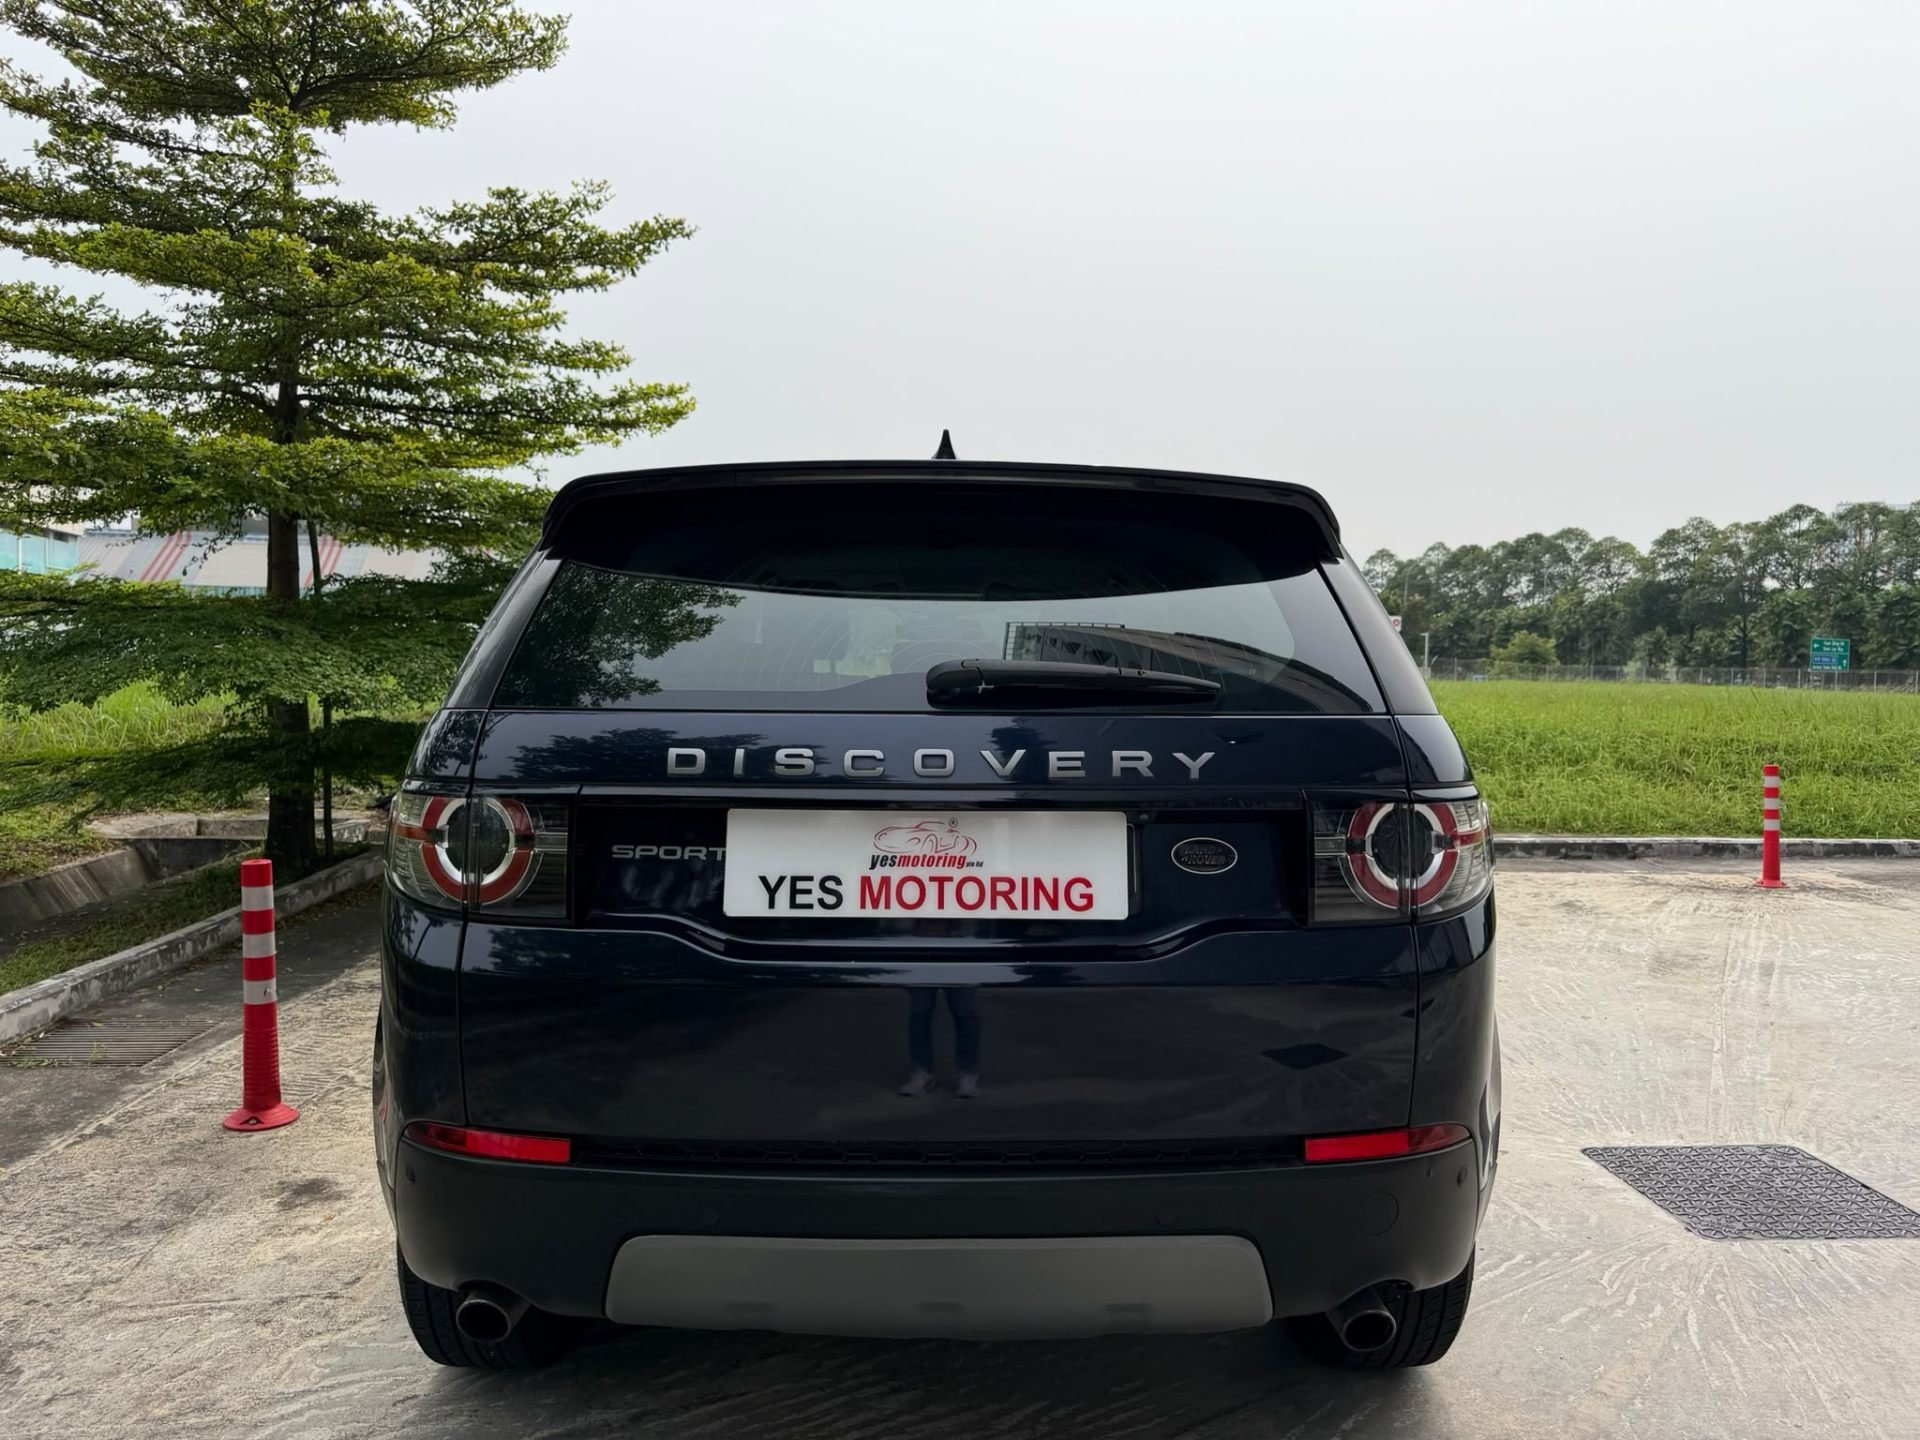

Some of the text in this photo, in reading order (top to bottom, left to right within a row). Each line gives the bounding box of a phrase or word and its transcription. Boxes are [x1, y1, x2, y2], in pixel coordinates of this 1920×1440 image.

[667, 747, 1215, 779] DISCOVERY
[611, 844, 726, 861] SPORT
[869, 853, 967, 870] yesmotoring
[758, 875, 1094, 912] YES MOTORING
